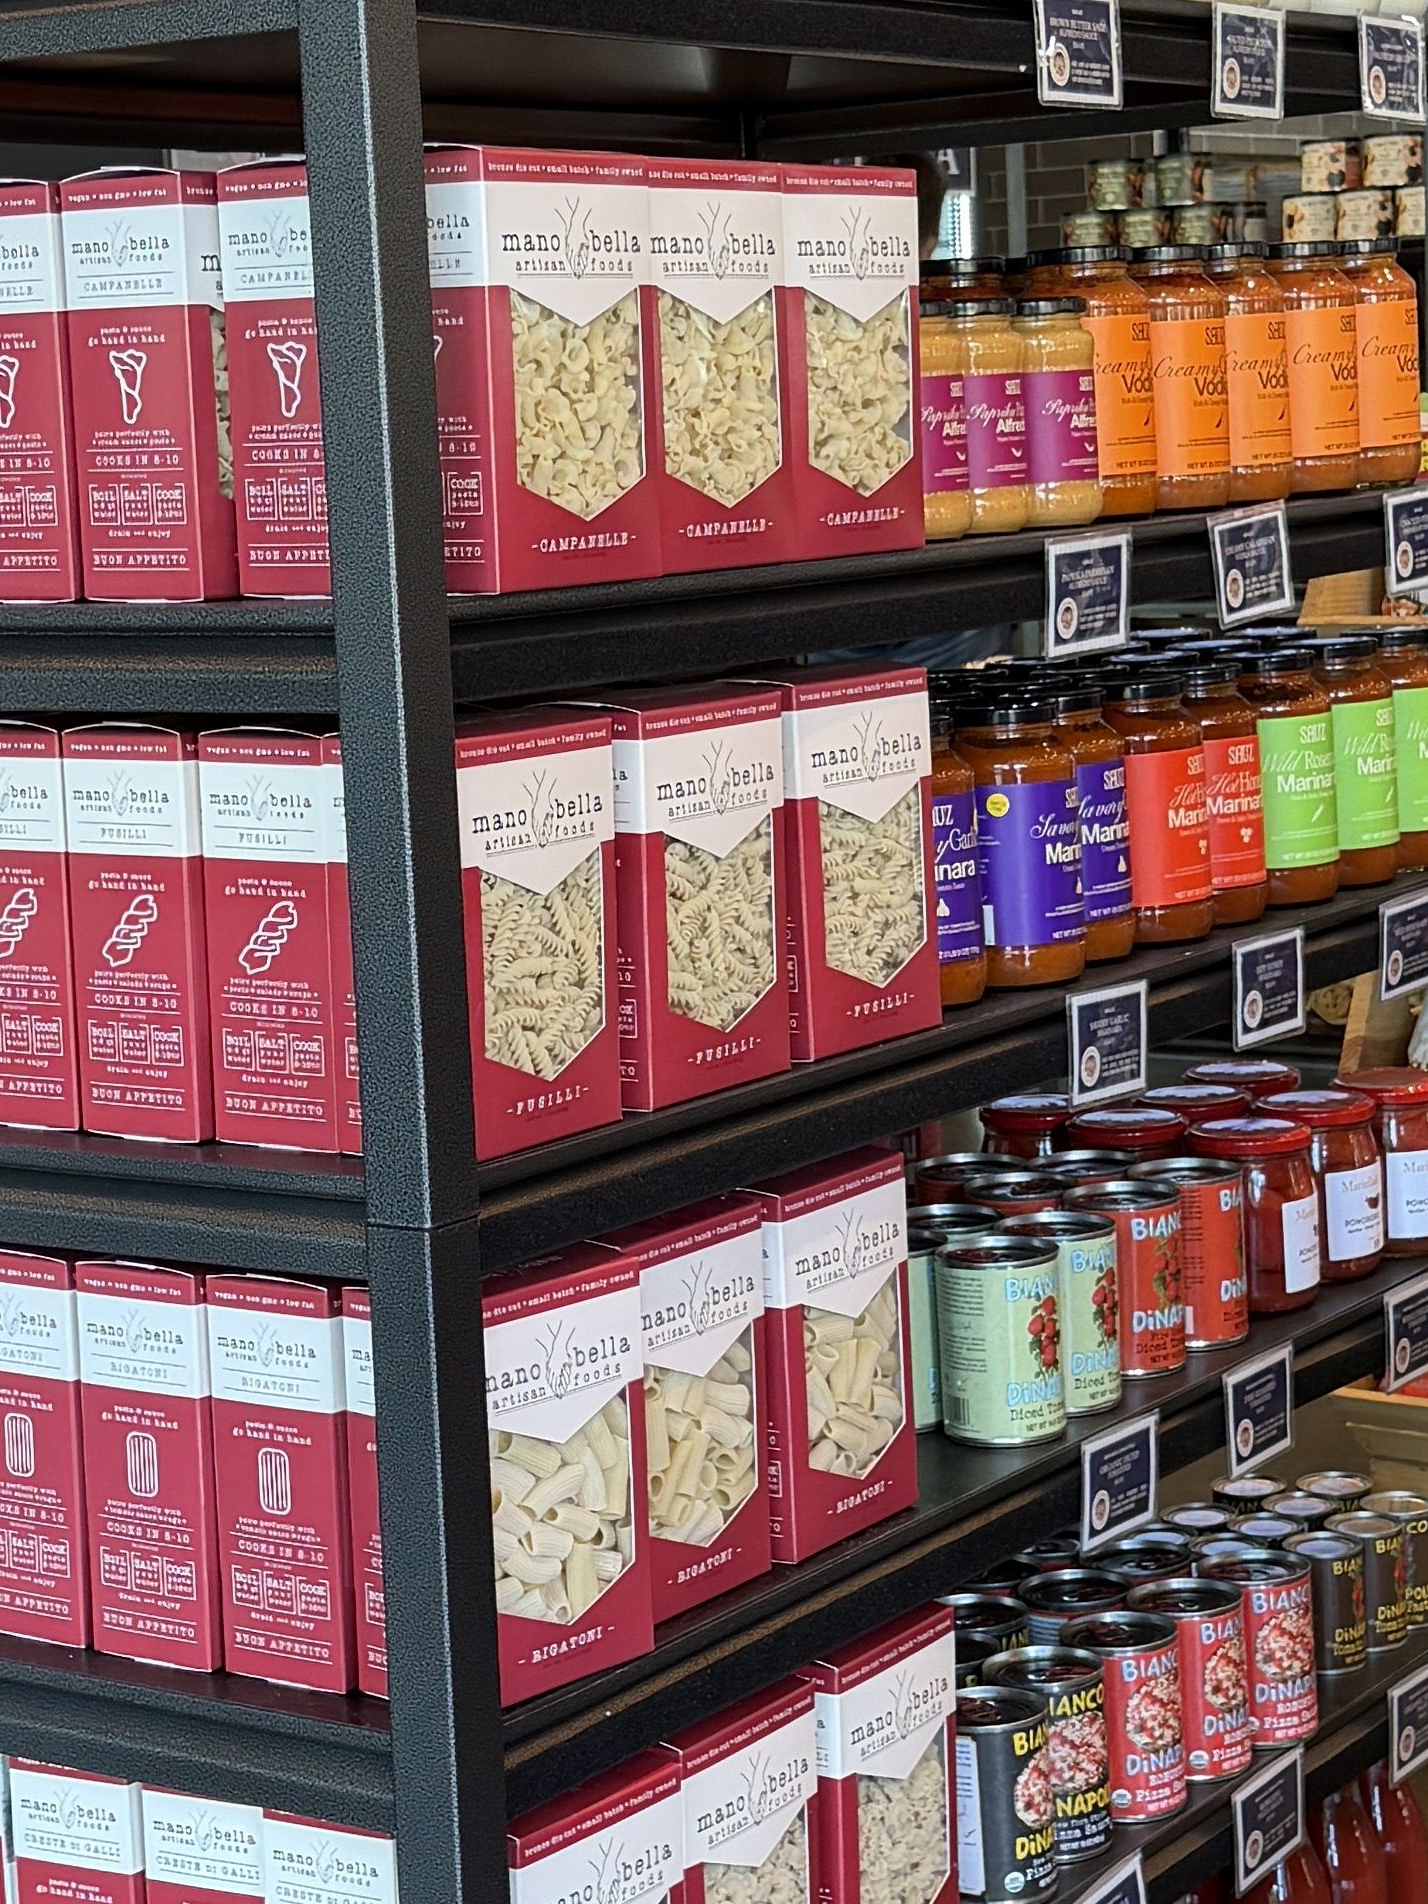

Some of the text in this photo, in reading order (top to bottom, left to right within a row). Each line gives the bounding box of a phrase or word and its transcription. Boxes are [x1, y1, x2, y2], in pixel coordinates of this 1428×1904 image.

[71, 232, 170, 256] mano bella
[502, 229, 640, 253] mano bella
[650, 234, 776, 256] mano bella
[797, 237, 911, 258] mano bella
[515, 258, 633, 273] artisan foods
[84, 277, 163, 294] CAMPANELLE
[811, 734, 922, 767] mano bella
[656, 764, 775, 801] mano bella
[1277, 771, 1335, 793] Marinar
[210, 790, 313, 812] mano bella
[472, 795, 603, 835] mano bella
[238, 831, 288, 847] FUSILLI
[483, 820, 595, 851] artisan foods
[795, 1220, 900, 1276] mano bella
[712, 1275, 754, 1304] bella
[86, 1321, 183, 1347] mano bella
[573, 1335, 630, 1364] bella
[110, 1359, 170, 1382] RIGATONI
[492, 1361, 622, 1410] artisan foods
[1252, 1585, 1309, 1615] BIANC
[850, 1672, 948, 1745] mano bella
[1049, 1685, 1104, 1718] IANCO
[697, 1754, 809, 1834] mano bella
[21, 1797, 116, 1825] mano bella
[623, 1842, 674, 1879] bella
[623, 1870, 664, 1899] foods
